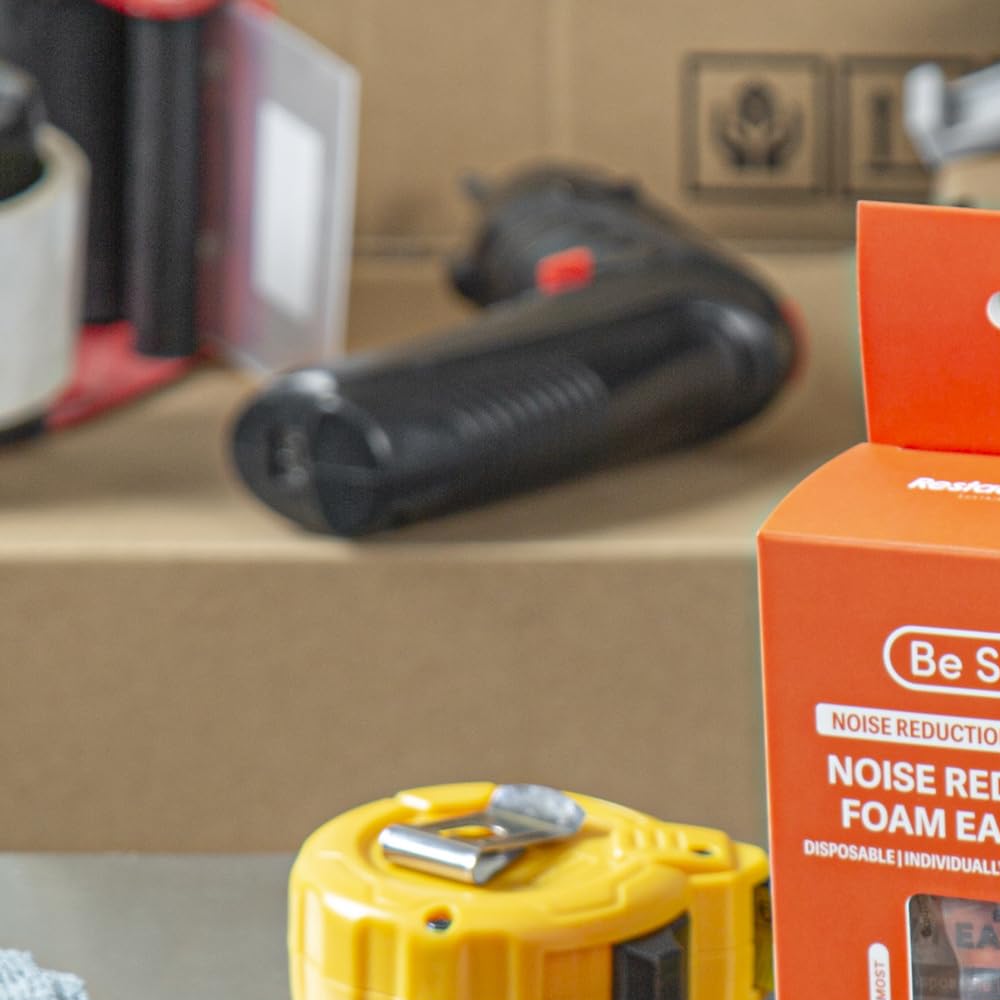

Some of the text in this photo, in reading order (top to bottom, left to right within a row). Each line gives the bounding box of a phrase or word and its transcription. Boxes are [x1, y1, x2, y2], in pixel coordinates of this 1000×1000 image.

[909, 640, 963, 679] Be
[831, 711, 892, 735] NOISE
[827, 755, 937, 795] NOISE
[841, 797, 947, 840] FOAM
